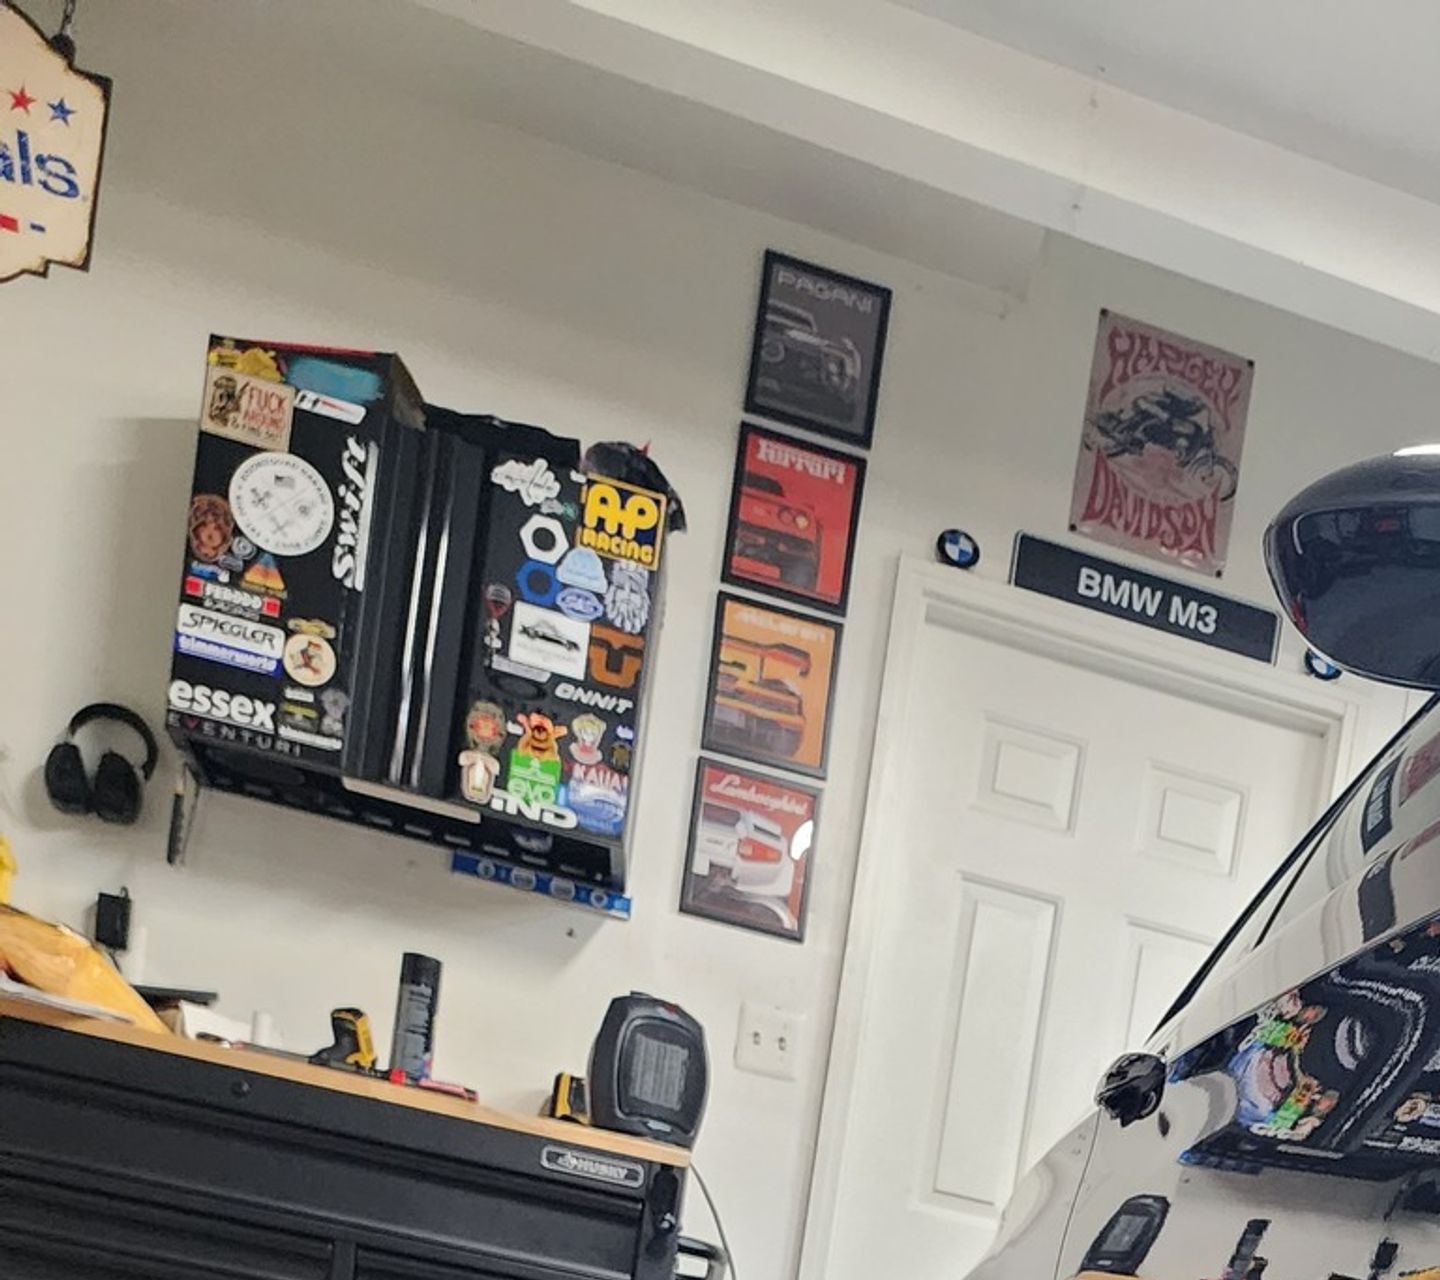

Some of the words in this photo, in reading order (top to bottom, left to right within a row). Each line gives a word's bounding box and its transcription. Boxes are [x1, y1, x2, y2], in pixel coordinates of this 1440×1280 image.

[777, 269, 874, 315] PAGANI
[1100, 325, 1243, 431] HARLEY
[756, 438, 846, 485] Ferrari
[584, 483, 659, 539] AP
[1080, 448, 1221, 558] DAVIDSON
[582, 527, 654, 564] RACING
[1076, 567, 1163, 618] BMW
[1168, 594, 1218, 635] M3
[182, 611, 277, 650] SPIEGLER
[169, 679, 277, 730] essex
[554, 682, 634, 715] ONNIT
[709, 773, 809, 817] Lamborghini
